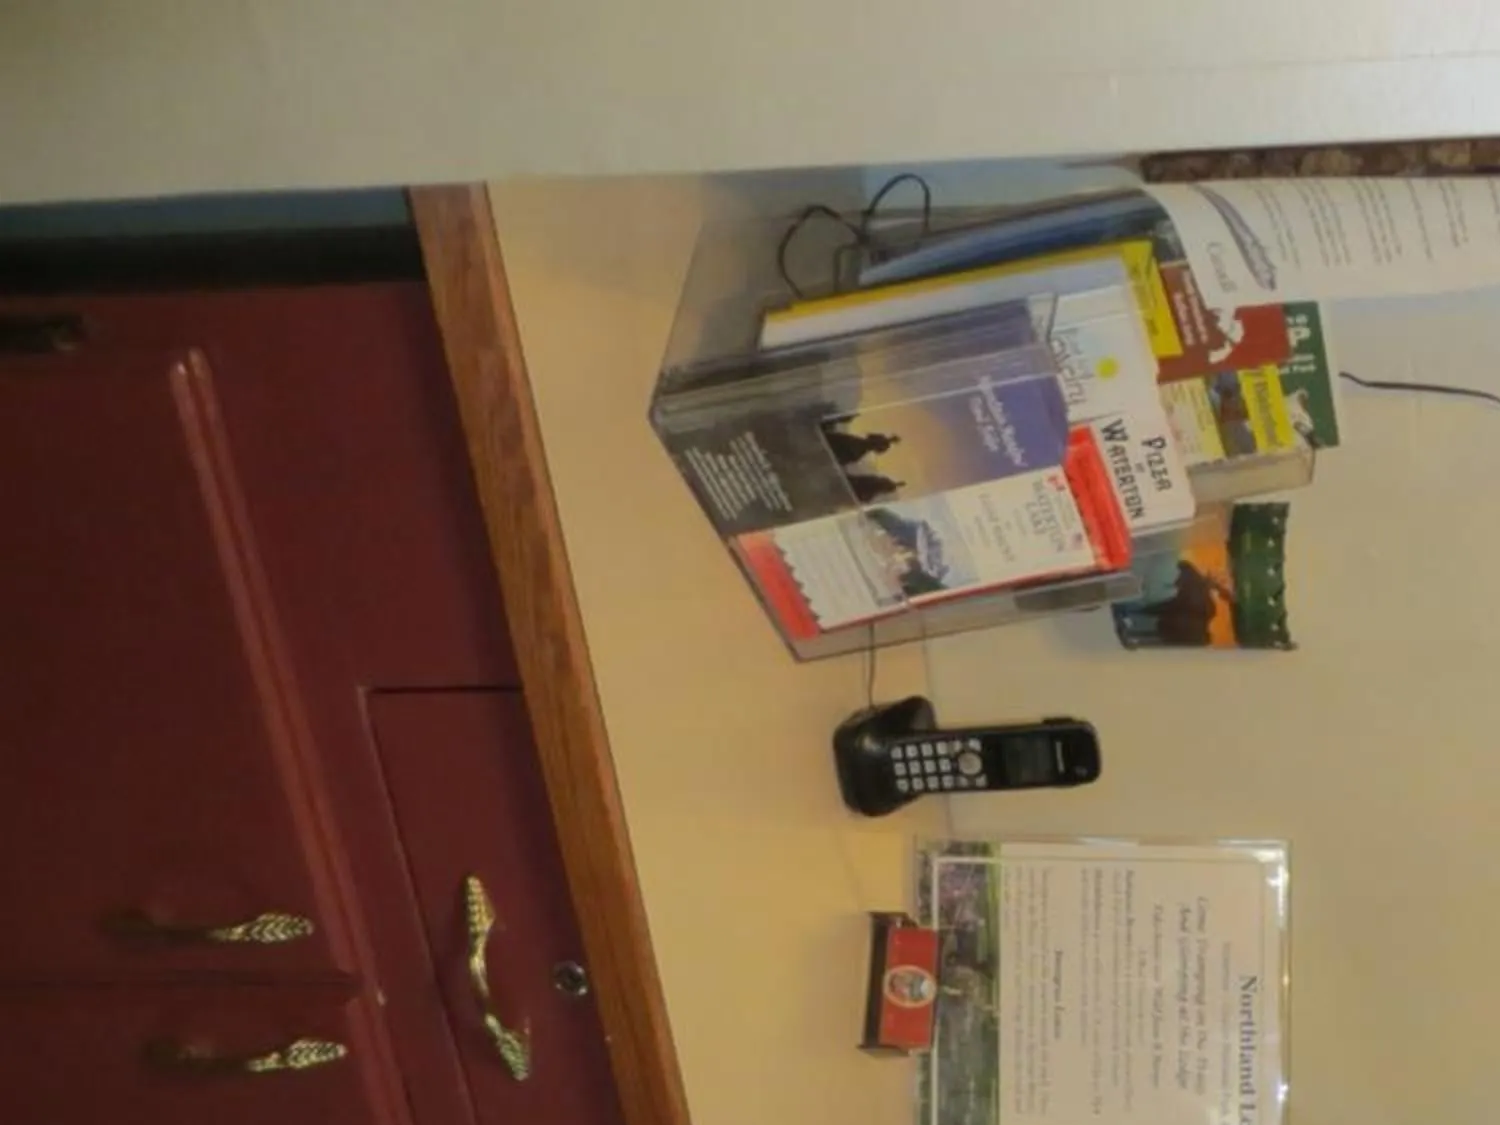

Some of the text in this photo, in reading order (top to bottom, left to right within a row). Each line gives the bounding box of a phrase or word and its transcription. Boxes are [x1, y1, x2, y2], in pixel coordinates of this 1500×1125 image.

[1102, 418, 1146, 519] WATERTON
[1141, 436, 1172, 492] PIZZA
[1237, 975, 1258, 1095] Northland
